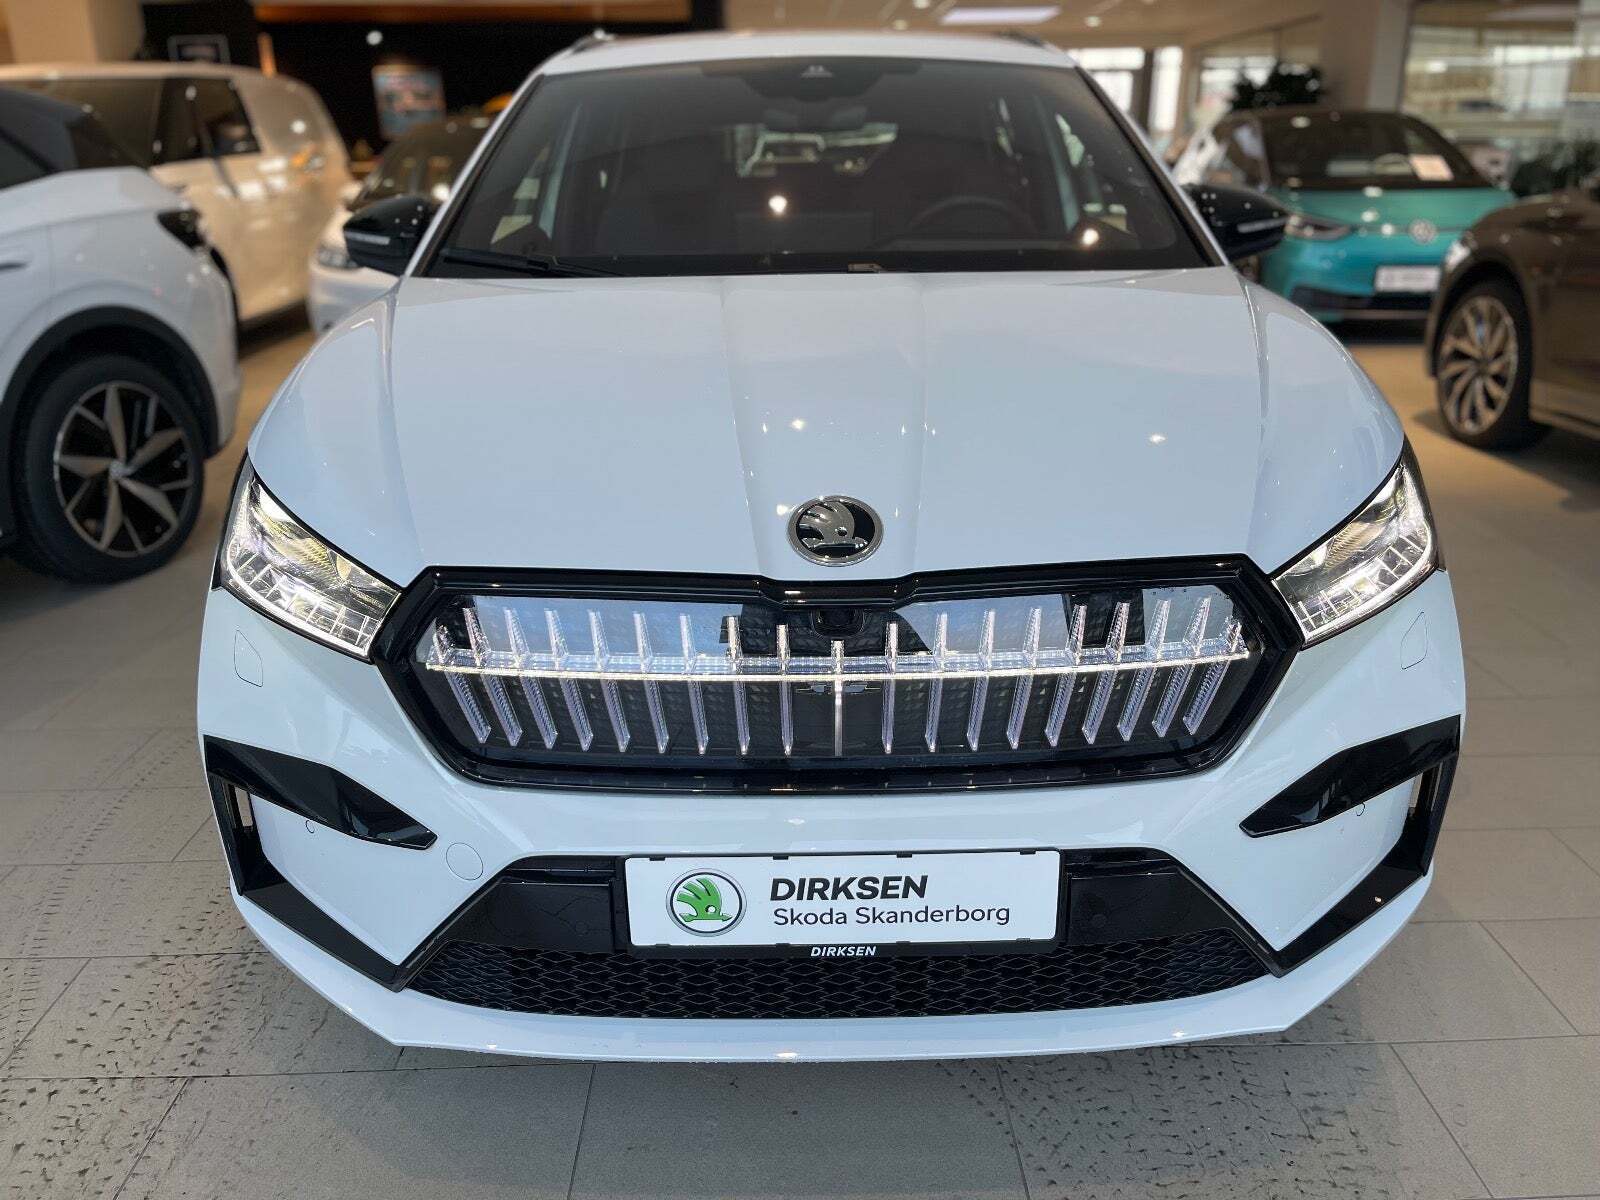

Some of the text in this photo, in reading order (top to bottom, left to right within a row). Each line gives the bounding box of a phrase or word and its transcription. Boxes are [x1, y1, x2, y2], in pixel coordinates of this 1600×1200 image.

[769, 874, 929, 902] DIRKSEN
[773, 904, 1010, 926] Skoda Skanderborg
[810, 945, 877, 957] DIRKSEN
